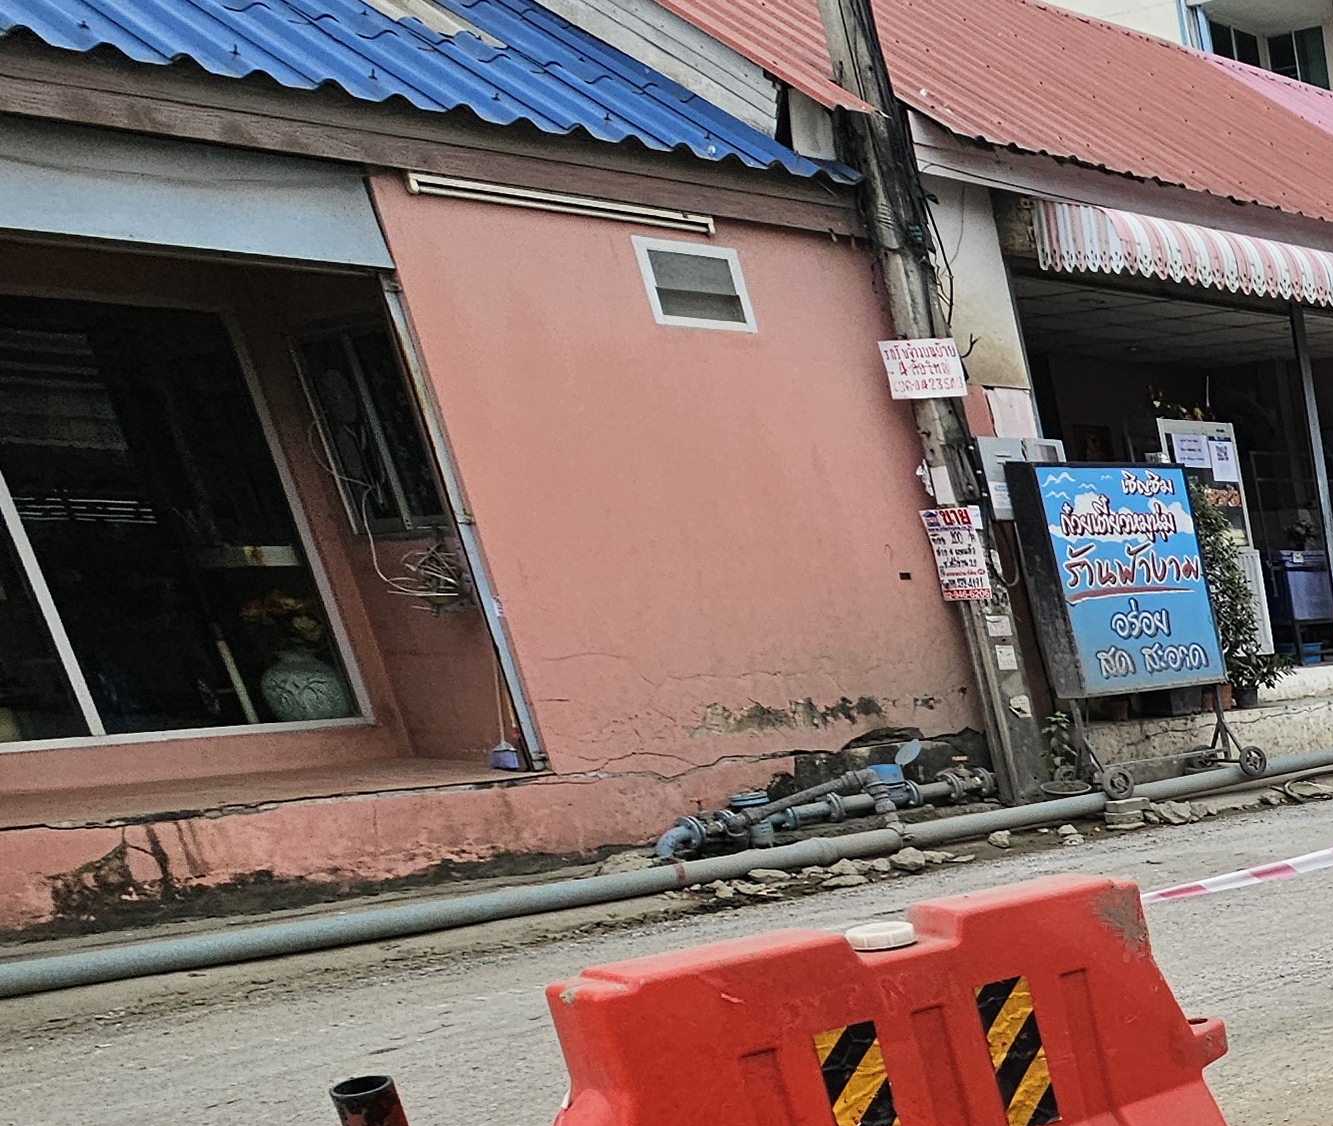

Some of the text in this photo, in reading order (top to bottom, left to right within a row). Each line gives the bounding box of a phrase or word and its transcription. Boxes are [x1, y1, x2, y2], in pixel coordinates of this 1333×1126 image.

[1120, 469, 1176, 496] เชิญชิม
[939, 508, 972, 526] ขาย
[1063, 542, 1201, 589] ร้านฟ้างาม
[1110, 597, 1171, 639] อร่อย
[1097, 640, 1209, 679] สด สะอาด
